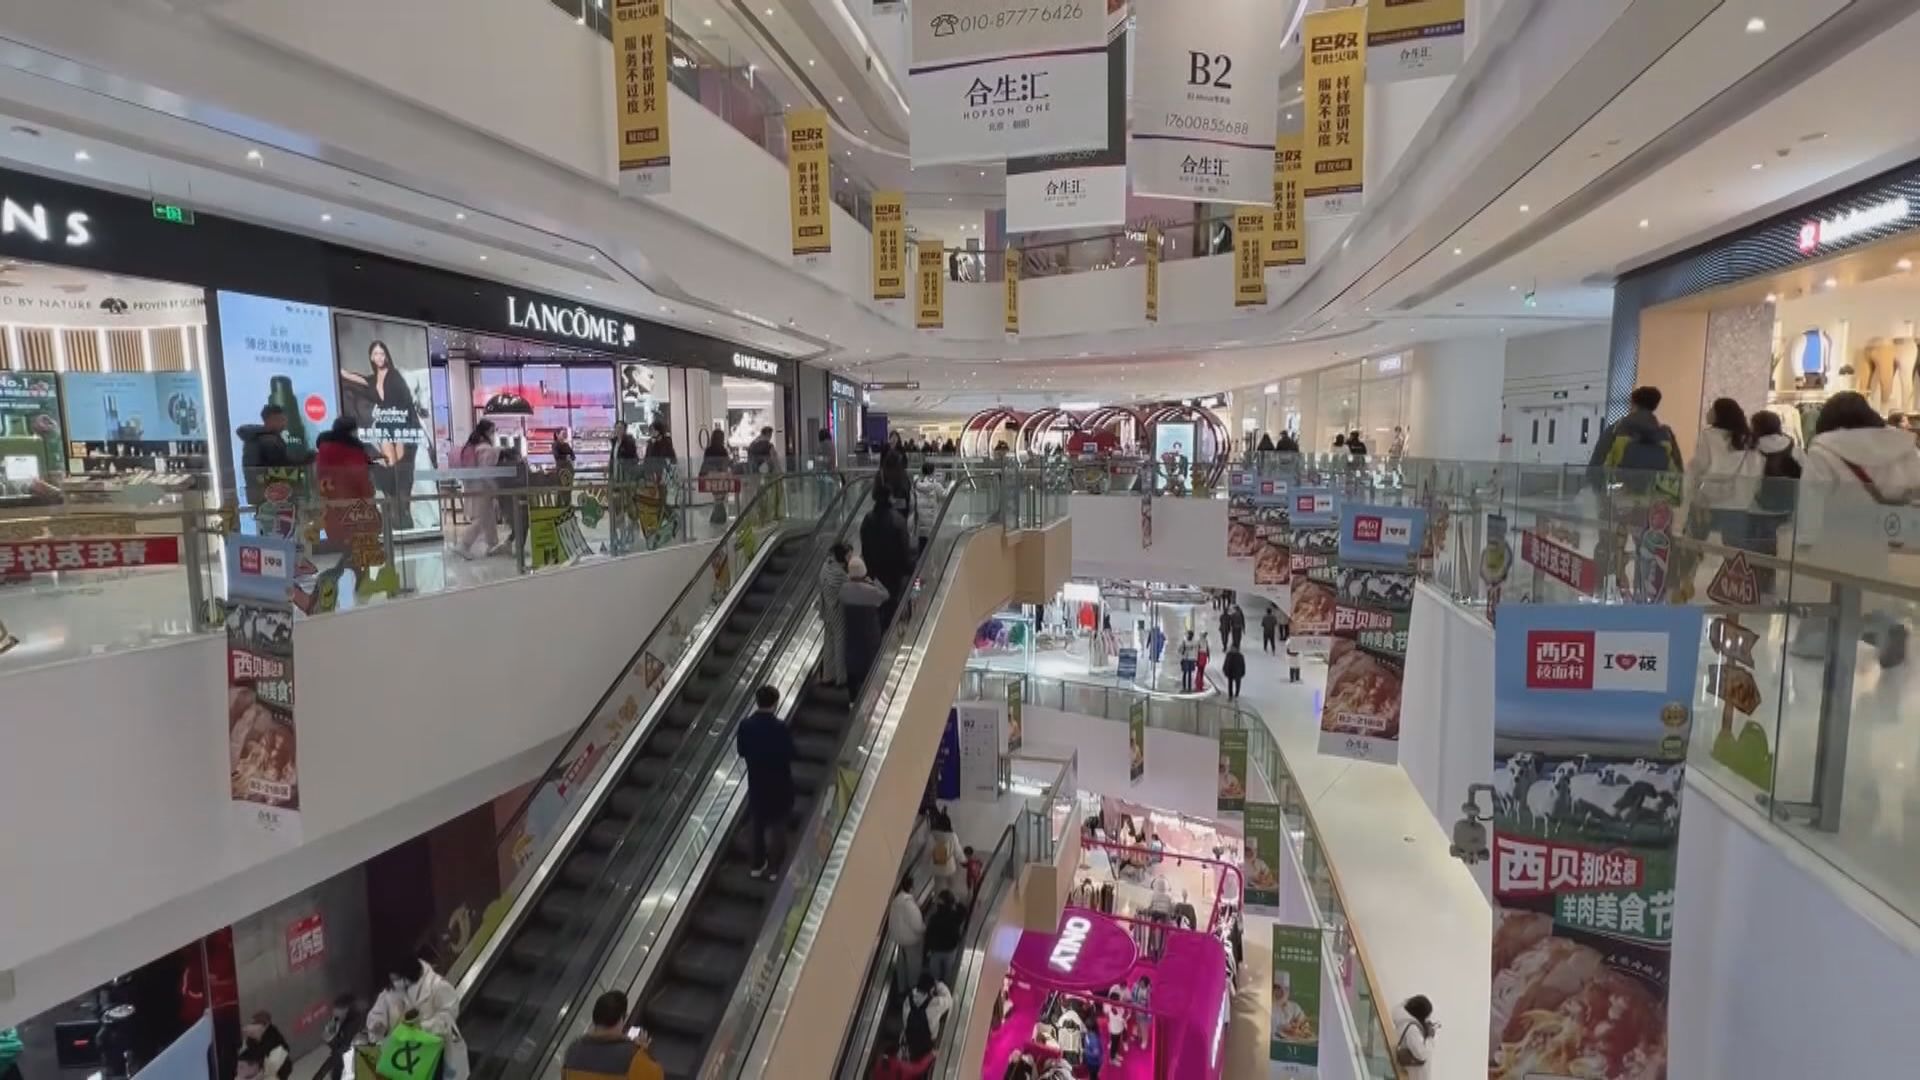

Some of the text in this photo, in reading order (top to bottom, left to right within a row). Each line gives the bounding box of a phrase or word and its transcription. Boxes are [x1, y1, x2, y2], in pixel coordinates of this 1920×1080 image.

[960, 3, 1083, 33] 010-87776426
[1311, 32, 1358, 53] 巴奴
[625, 36, 639, 114] 服务不过度
[641, 33, 656, 112] 样样都讲究
[1187, 50, 1232, 89] B2
[964, 71, 1049, 107] 合生汇
[963, 104, 1051, 120] HOPSON ONE
[1165, 113, 1249, 135] 17600855688
[1318, 78, 1332, 147] 服务不过度
[1336, 75, 1350, 145] 样样都讲究
[1180, 154, 1230, 177] 合生汇
[507, 296, 619, 345] LANCÔME
[733, 352, 779, 376] GIVENCHY
[1535, 641, 1585, 663] 西贝
[1639, 655, 1657, 672] 莜
[1536, 663, 1584, 680] 莜面村
[1497, 836, 1637, 891] 西贝那达慕
[1562, 888, 1675, 936] 羊肉美食节
[1049, 916, 1092, 972] ONLY
